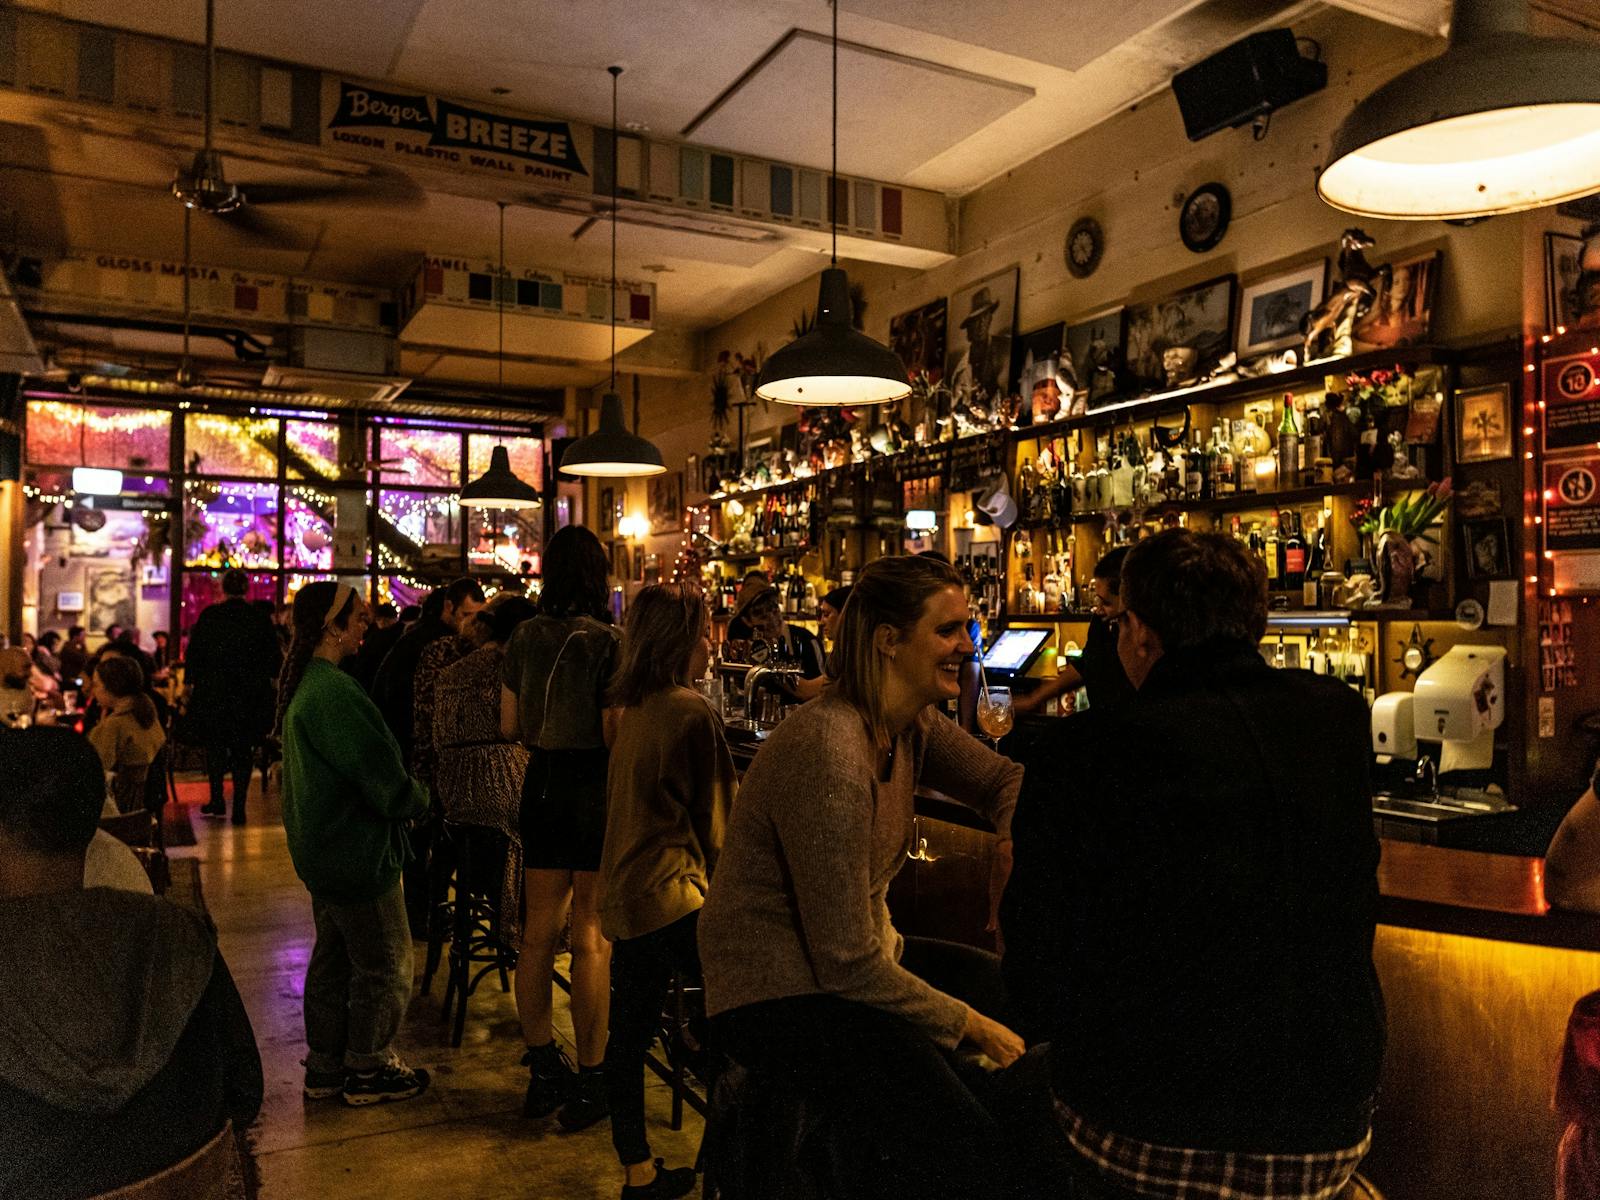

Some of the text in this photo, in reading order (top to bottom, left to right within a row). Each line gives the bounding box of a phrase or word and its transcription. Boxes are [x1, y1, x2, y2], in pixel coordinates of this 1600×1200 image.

[346, 90, 428, 125] Berger
[333, 131, 573, 182] LOXON PLASTIC WALL PAINT
[446, 112, 567, 160] BREEZE
[96, 255, 152, 273] GLOSS
[160, 262, 220, 281] MASTA
